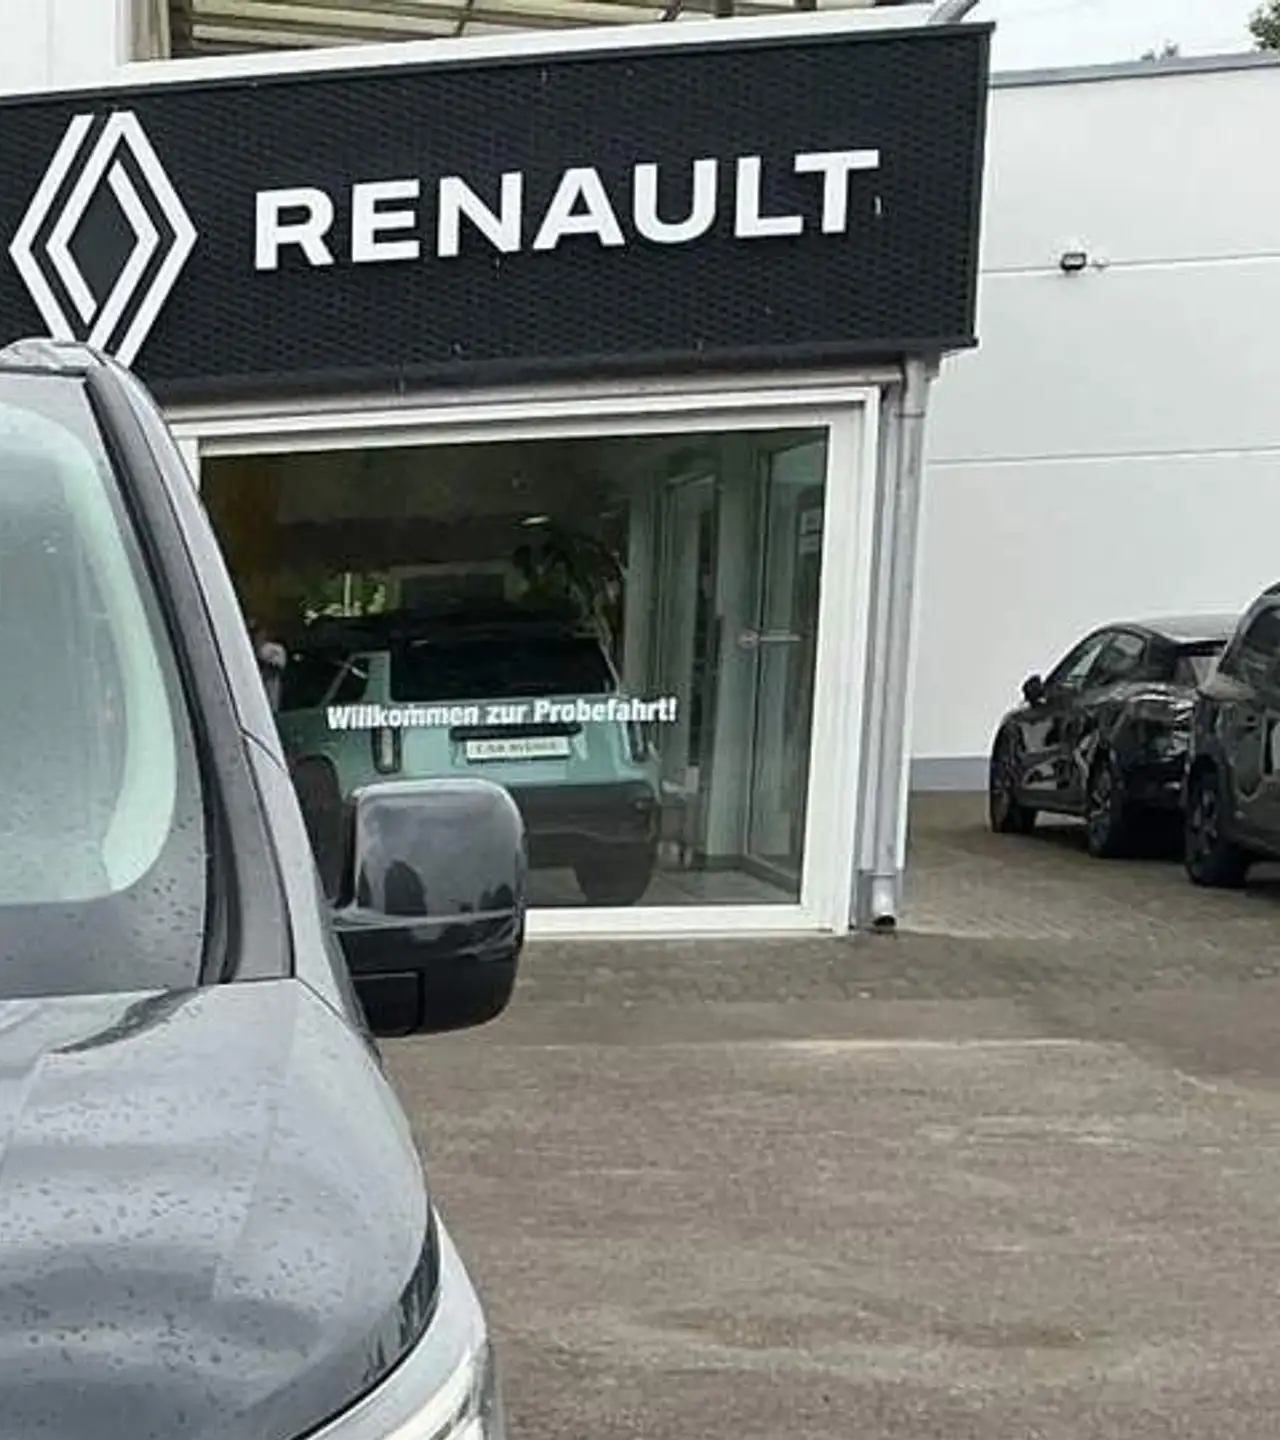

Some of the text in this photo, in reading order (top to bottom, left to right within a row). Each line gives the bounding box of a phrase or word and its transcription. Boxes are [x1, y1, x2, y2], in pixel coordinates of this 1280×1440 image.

[254, 149, 880, 271] RENAULT
[327, 698, 677, 730] Willkommen zur Probefahrt!
